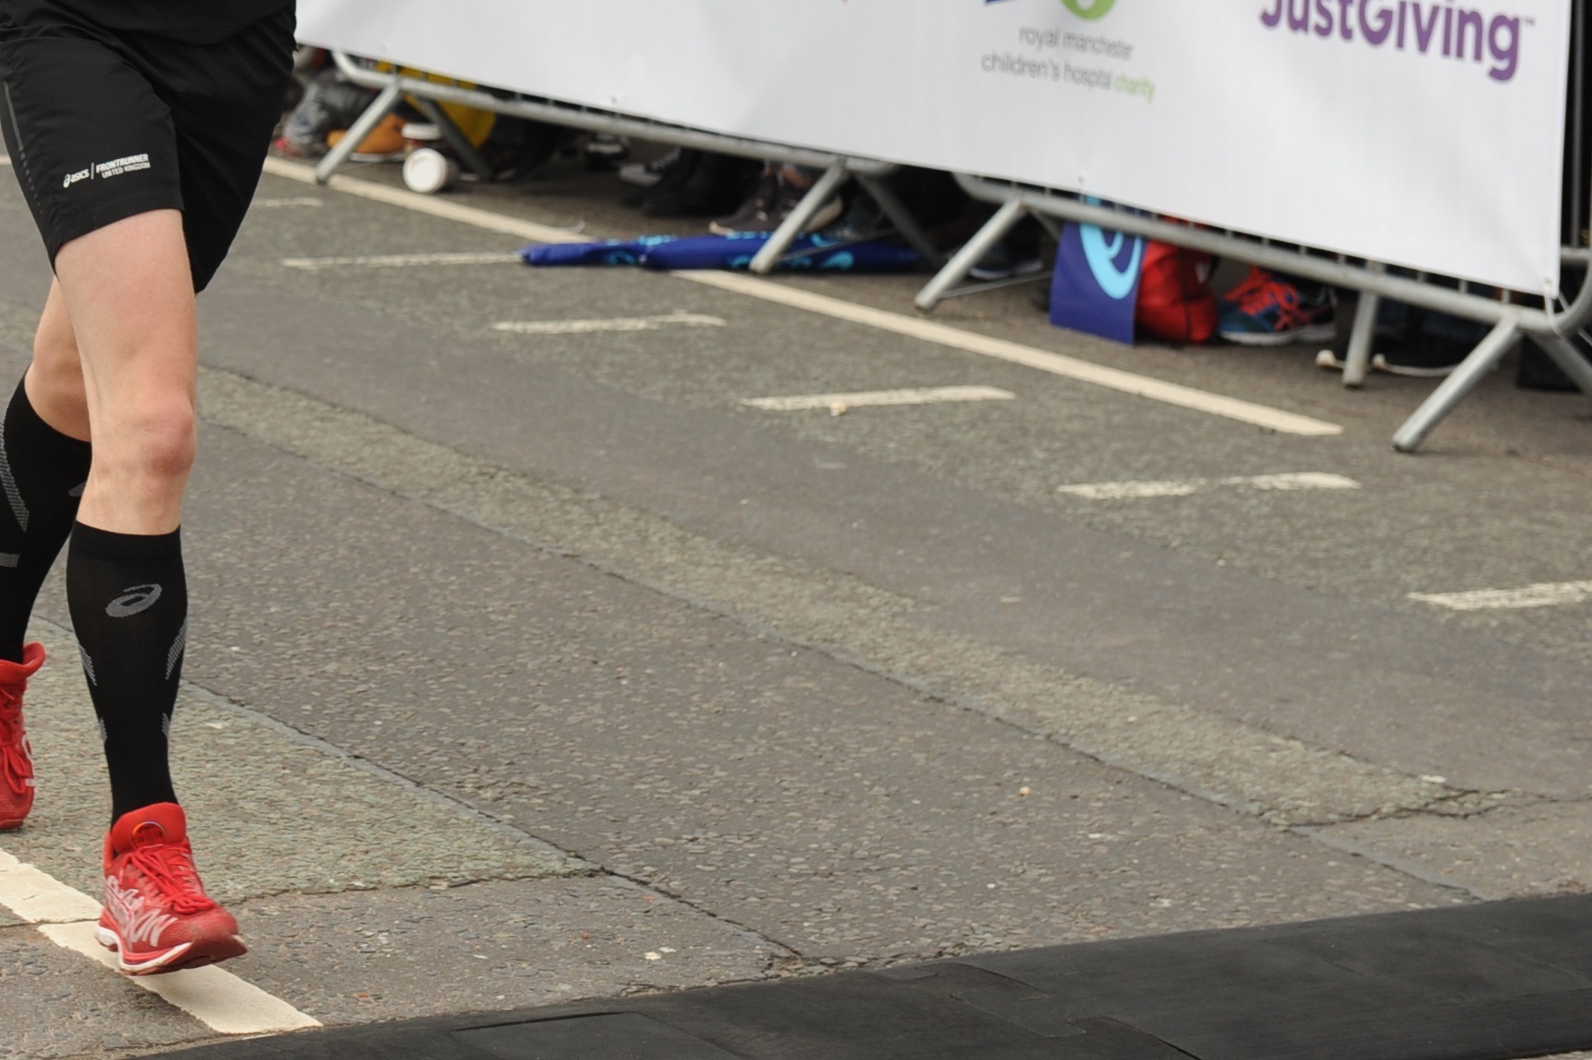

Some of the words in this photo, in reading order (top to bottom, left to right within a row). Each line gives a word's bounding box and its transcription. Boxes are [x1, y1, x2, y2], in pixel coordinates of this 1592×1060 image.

[1019, 26, 1059, 52] royal
[1062, 30, 1133, 61] manchester
[980, 50, 1061, 82] children's
[1063, 60, 1112, 91] hospital
[1114, 71, 1156, 104] charity
[101, 166, 124, 179] UNITED
